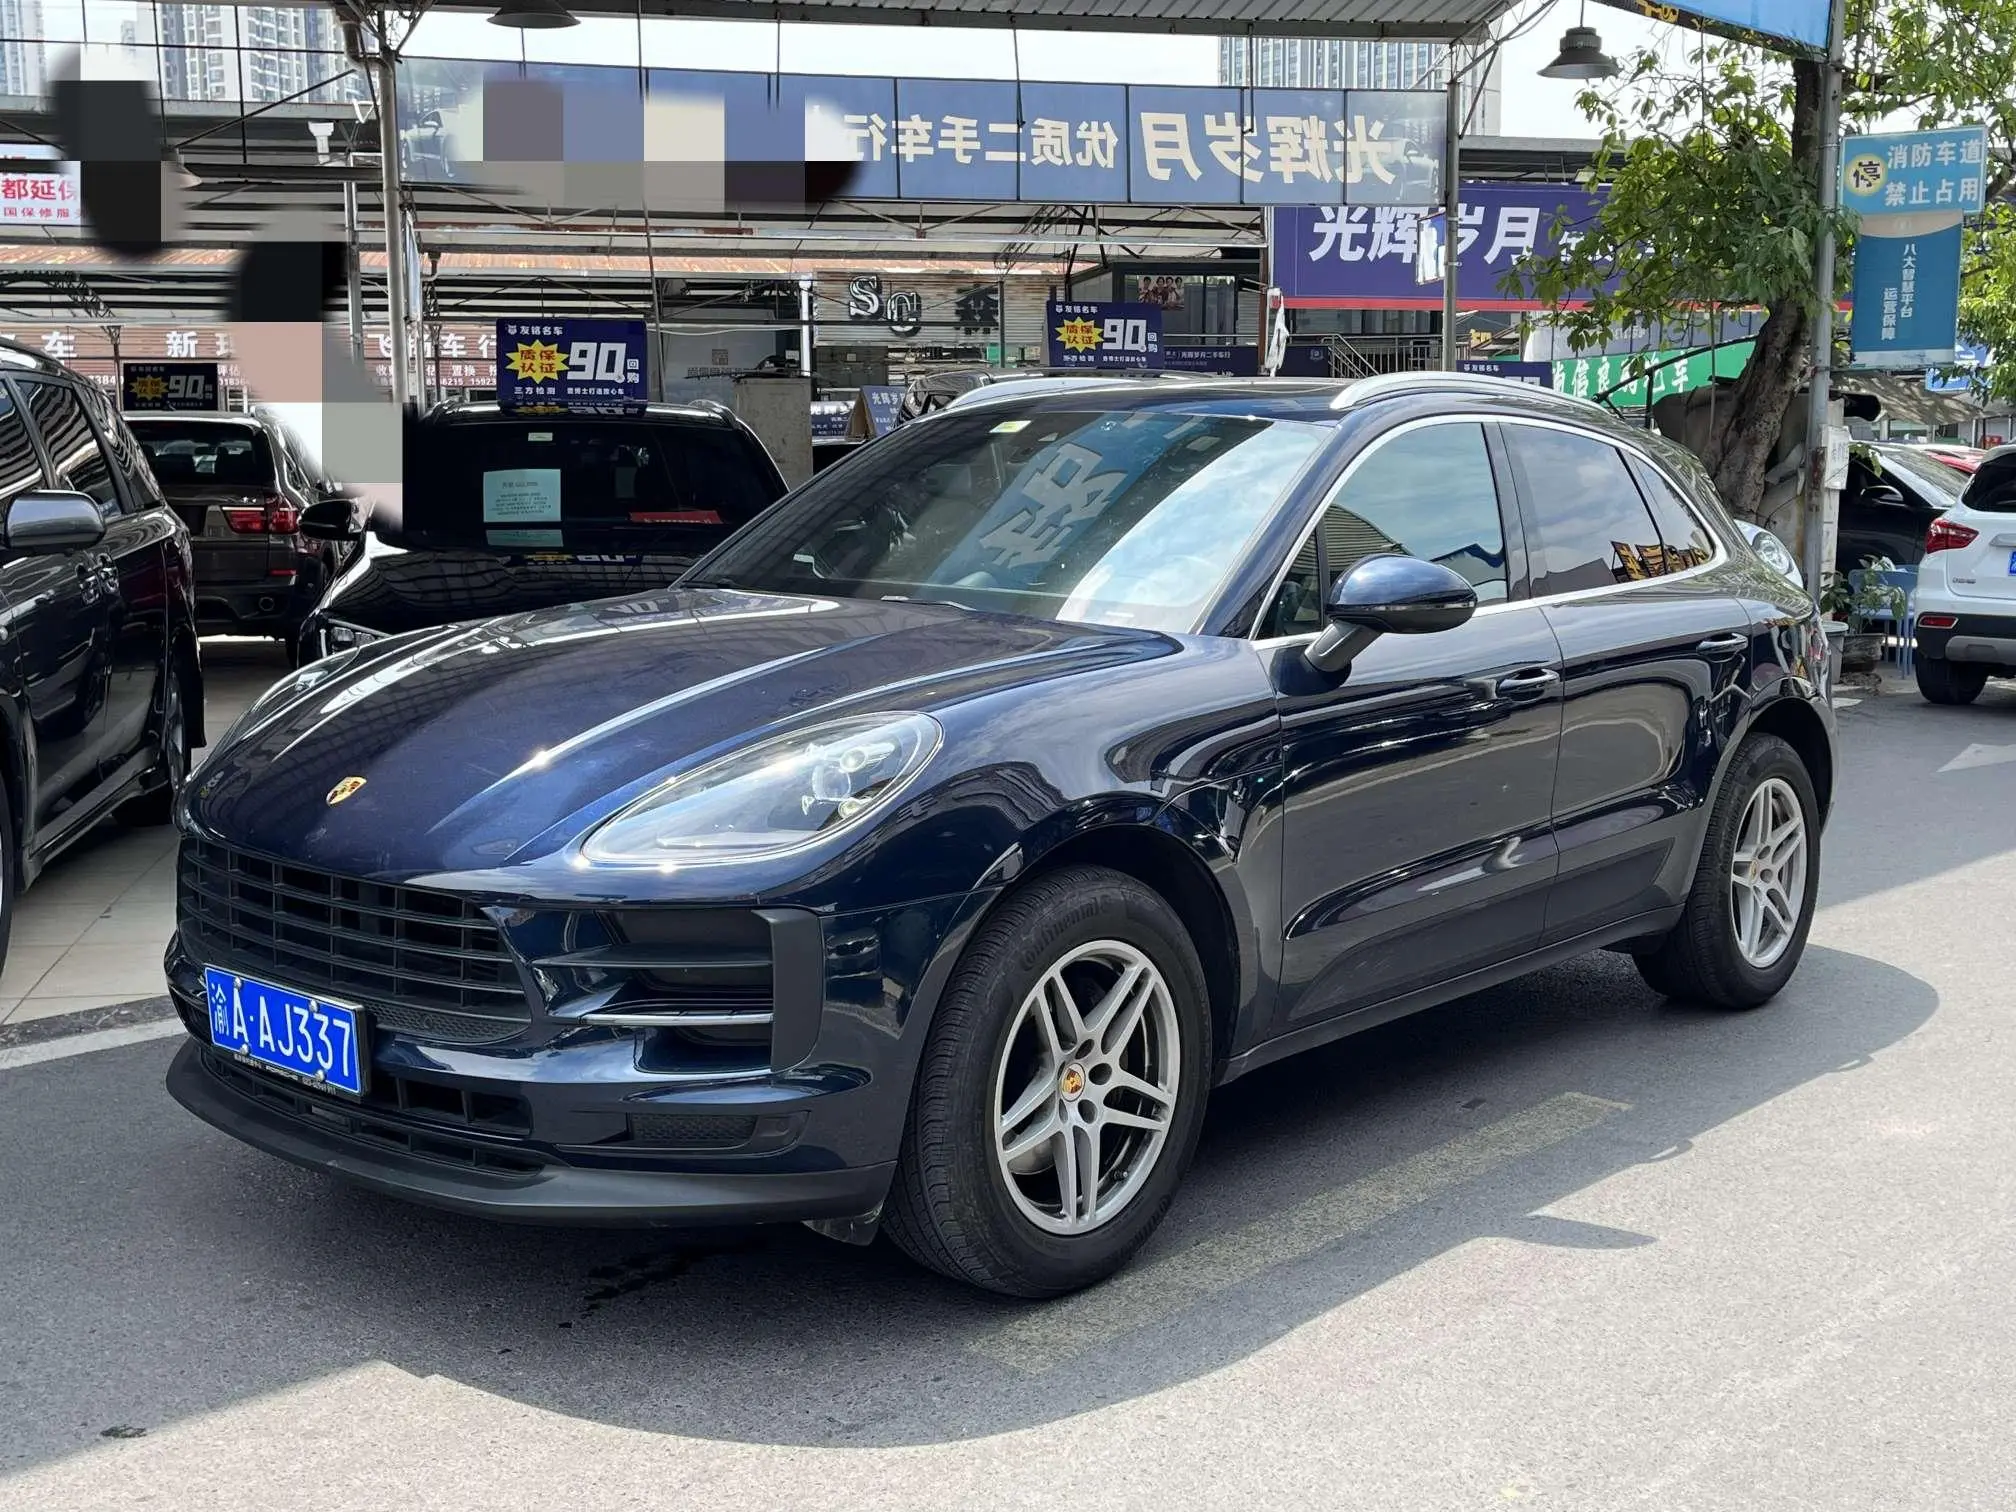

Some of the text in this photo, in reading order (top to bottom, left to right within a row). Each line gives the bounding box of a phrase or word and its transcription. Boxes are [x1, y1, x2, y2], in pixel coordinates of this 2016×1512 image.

[1887, 139, 1983, 169] 消防车道
[1853, 160, 1881, 188] 停
[1884, 177, 1979, 207] 禁止占用
[1900, 243, 1917, 318] 八大智慧平台
[1881, 287, 1898, 341] 运营保障
[1102, 319, 1147, 350] 90
[519, 349, 556, 361] 质保
[519, 362, 556, 374] 认证
[567, 342, 627, 381] 90
[627, 359, 640, 384] 回购
